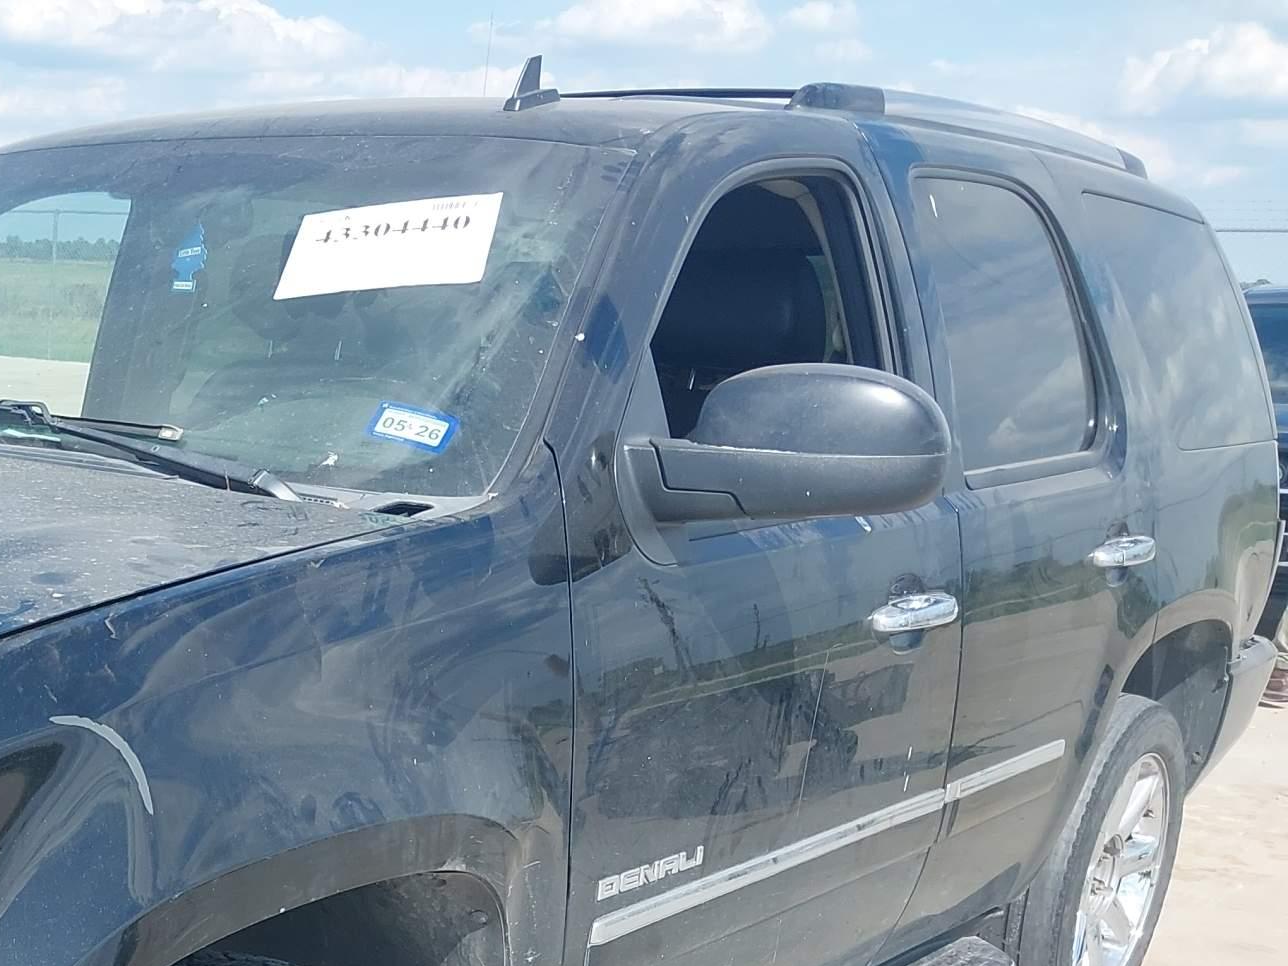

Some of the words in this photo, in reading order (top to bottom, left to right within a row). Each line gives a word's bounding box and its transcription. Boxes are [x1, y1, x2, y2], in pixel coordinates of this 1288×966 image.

[315, 215, 471, 243] 43304440
[382, 416, 408, 432] 05
[415, 425, 441, 441] 26
[597, 845, 705, 902] DENALI
